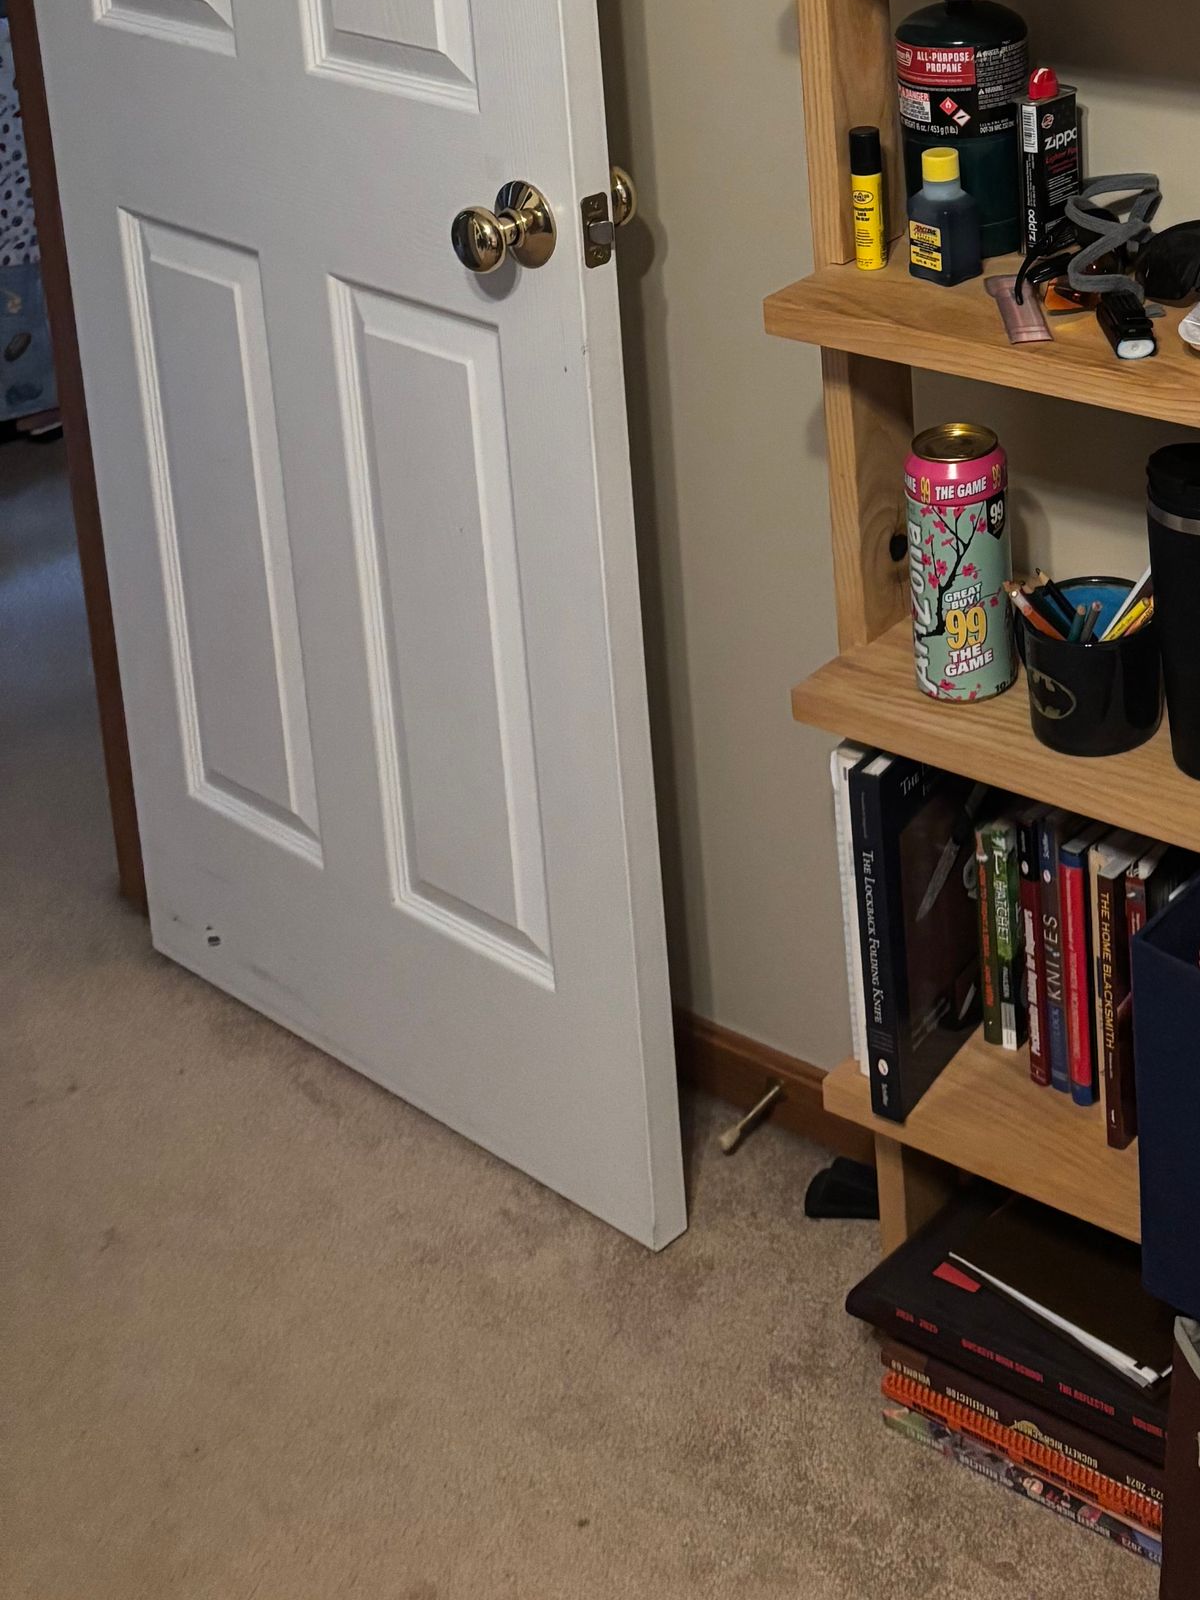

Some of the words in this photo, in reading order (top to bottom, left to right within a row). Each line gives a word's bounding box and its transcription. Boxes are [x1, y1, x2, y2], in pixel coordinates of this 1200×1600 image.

[917, 51, 971, 62] ALL-PURPOSE
[925, 62, 962, 73] PROPANE
[930, 125, 940, 134] 453
[1044, 127, 1078, 151] zippo
[1028, 209, 1038, 242] zippo
[920, 476, 930, 504] 99
[935, 485, 955, 501] THE
[957, 476, 986, 498] GAME
[990, 500, 1003, 524] 99
[944, 582, 982, 603] GREAT
[951, 593, 981, 610] BUY!
[945, 607, 987, 650] 99
[944, 649, 994, 678] GAME
[950, 643, 983, 664] THE
[862, 851, 874, 874] THE
[864, 877, 876, 936] LOCKBACK
[993, 880, 1010, 943] HATCHET
[1101, 892, 1110, 919] THE
[1102, 922, 1111, 962] HOME
[868, 938, 880, 988] FOLDING
[872, 988, 884, 1024] KNIFE
[1103, 964, 1115, 1049] BLACKSMITH
[986, 1407, 999, 1420] THE
[1064, 1446, 1098, 1468] BUCKEYE
[1126, 1475, 1147, 1493] 2024
